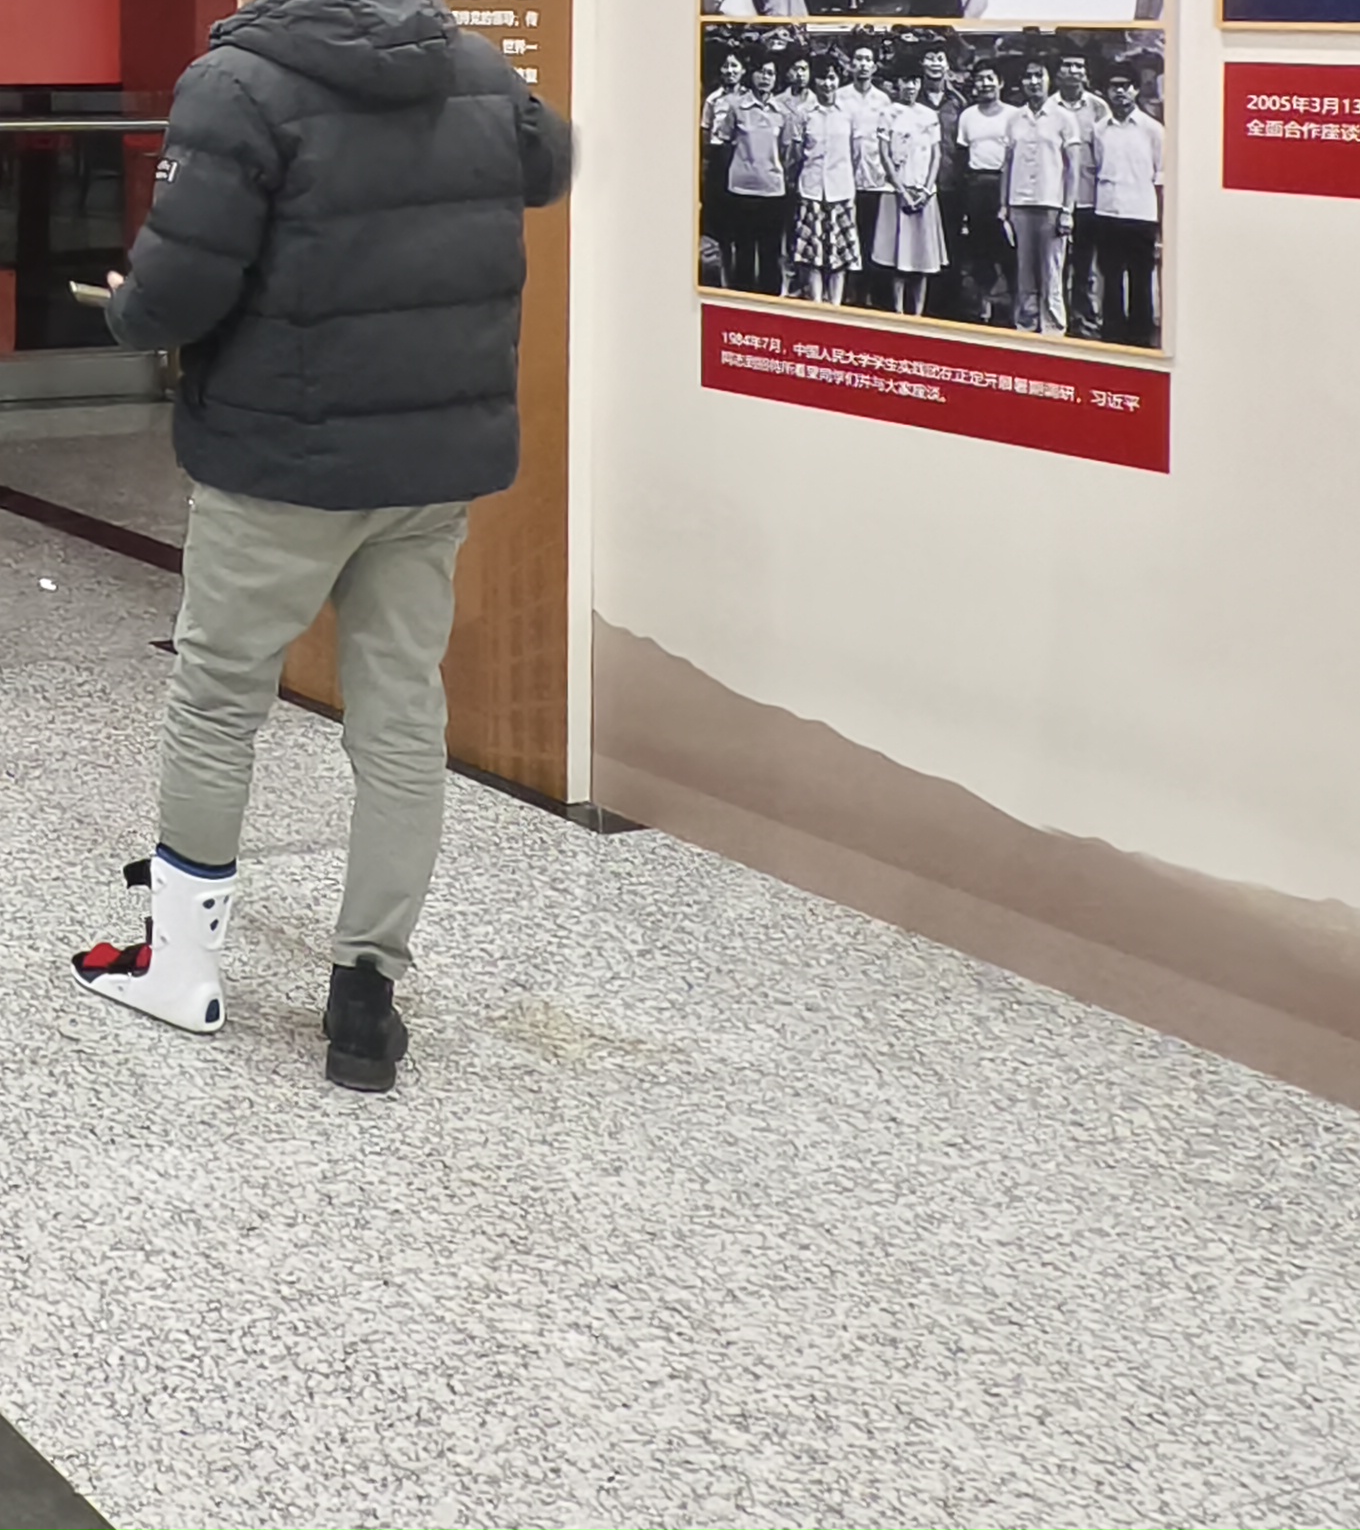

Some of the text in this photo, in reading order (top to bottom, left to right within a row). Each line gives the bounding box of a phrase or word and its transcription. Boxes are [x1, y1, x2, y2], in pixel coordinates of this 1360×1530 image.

[1246, 94, 1360, 116] 2005年3月13
[1246, 118, 1360, 143] 全面合作座谈
